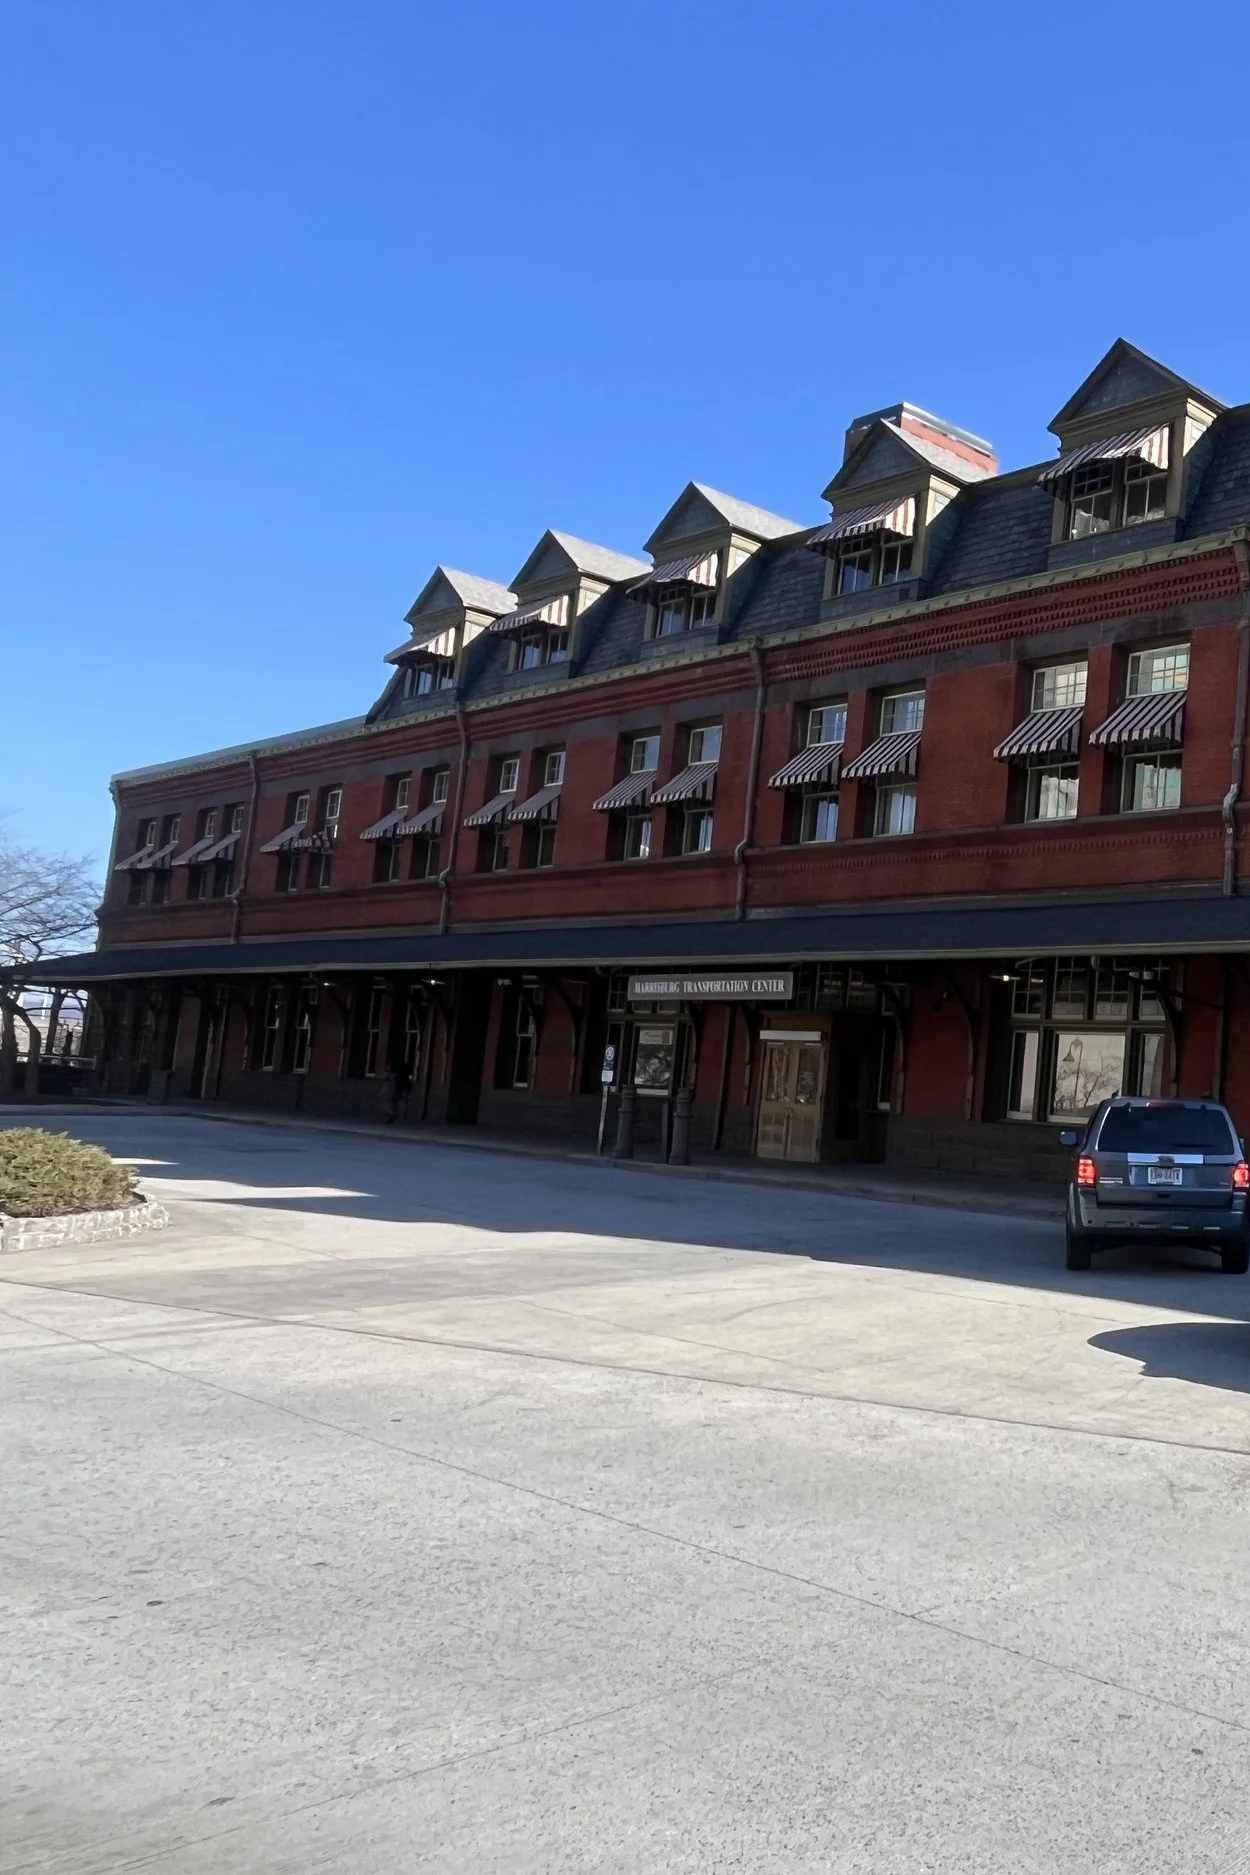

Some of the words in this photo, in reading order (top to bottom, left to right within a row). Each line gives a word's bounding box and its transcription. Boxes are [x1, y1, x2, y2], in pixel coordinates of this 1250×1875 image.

[634, 981, 680, 994] HARRISBURG
[683, 980, 749, 993] TRANSPORTATION
[751, 979, 784, 992] CENTER
